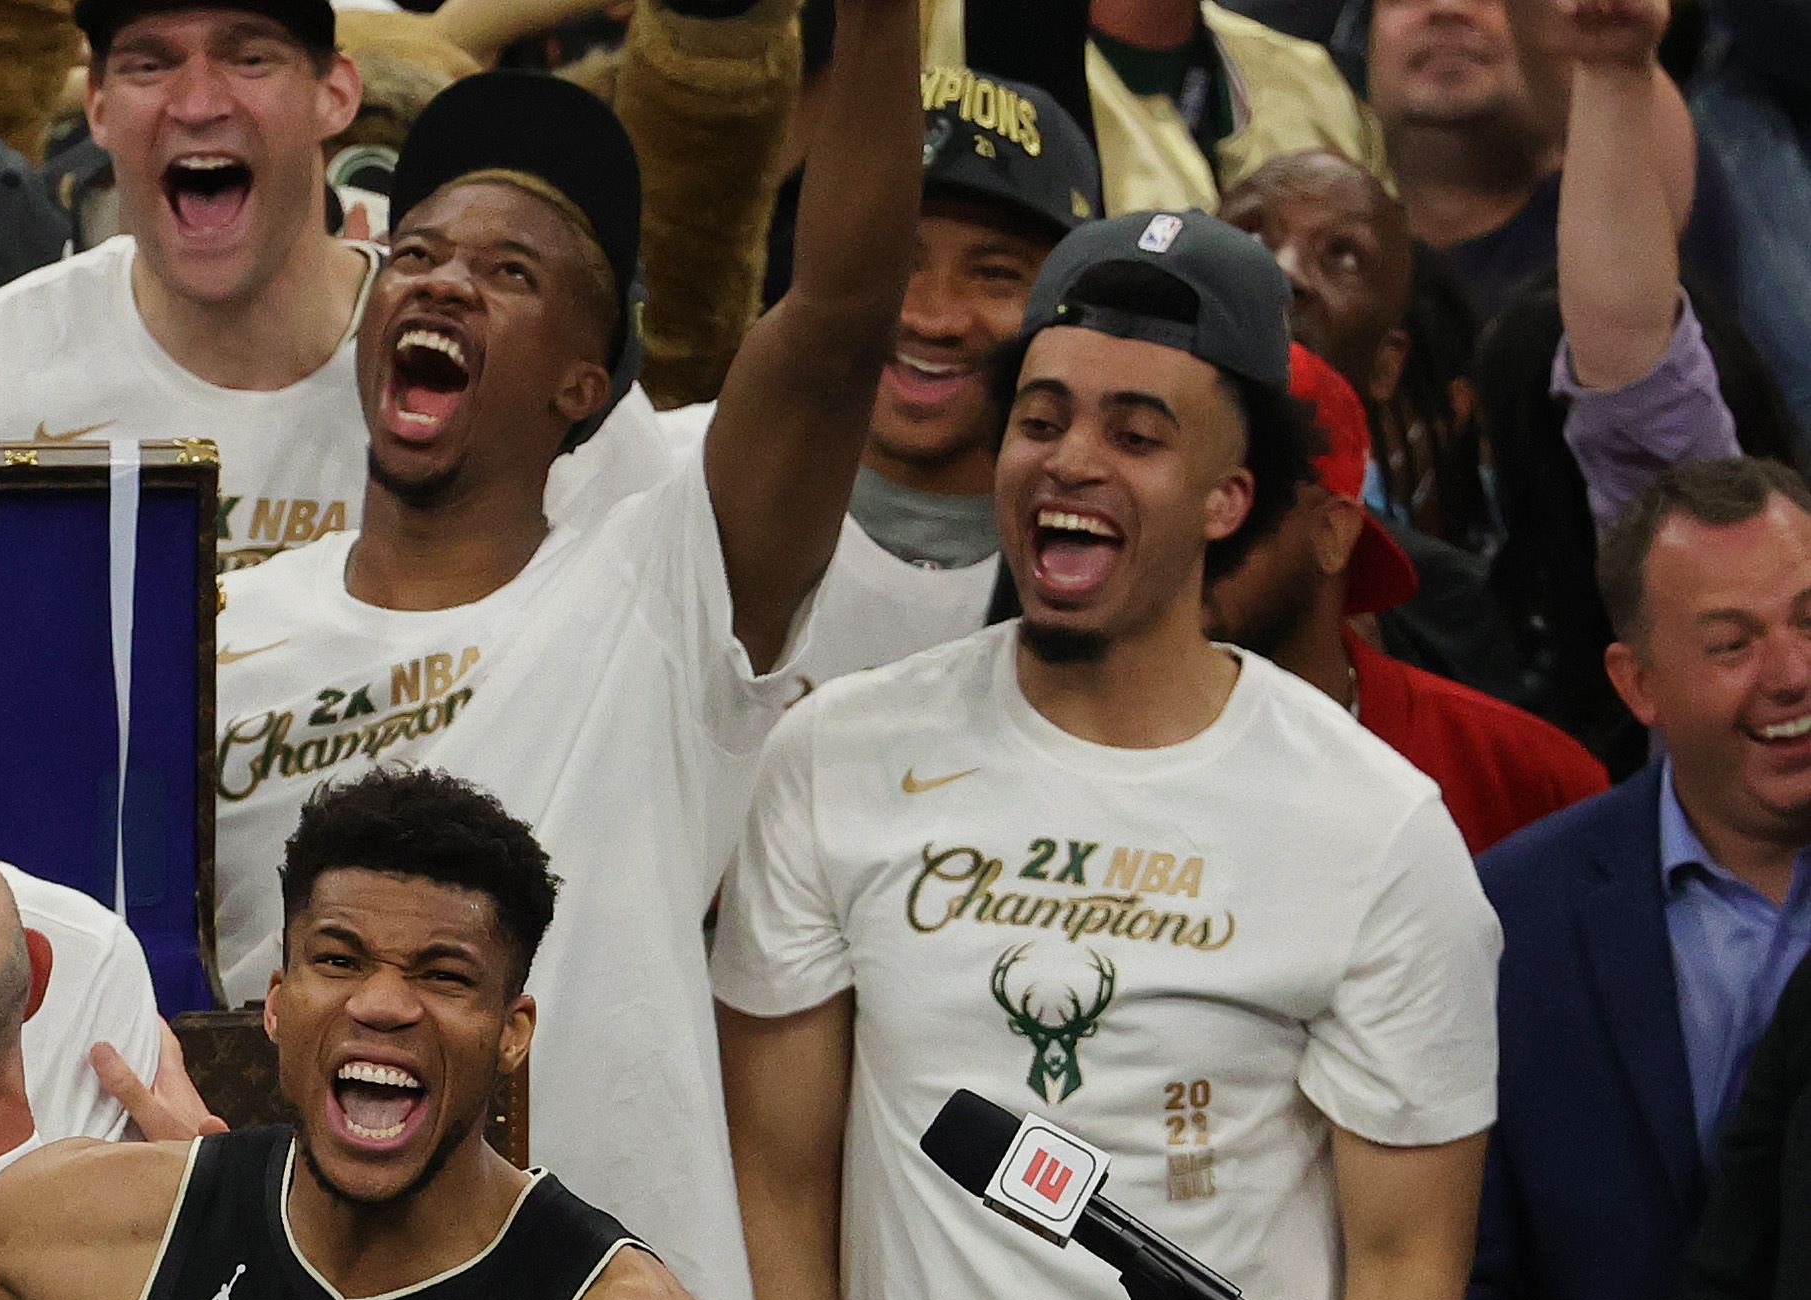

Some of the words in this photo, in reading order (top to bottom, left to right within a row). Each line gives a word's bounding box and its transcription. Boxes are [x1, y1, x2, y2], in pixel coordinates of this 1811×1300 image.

[249, 496, 346, 541] NBA
[1018, 838, 1099, 886] 2X
[1102, 847, 1205, 898] NBA
[906, 840, 1236, 951] Champions
[1164, 1079, 1211, 1110] 20
